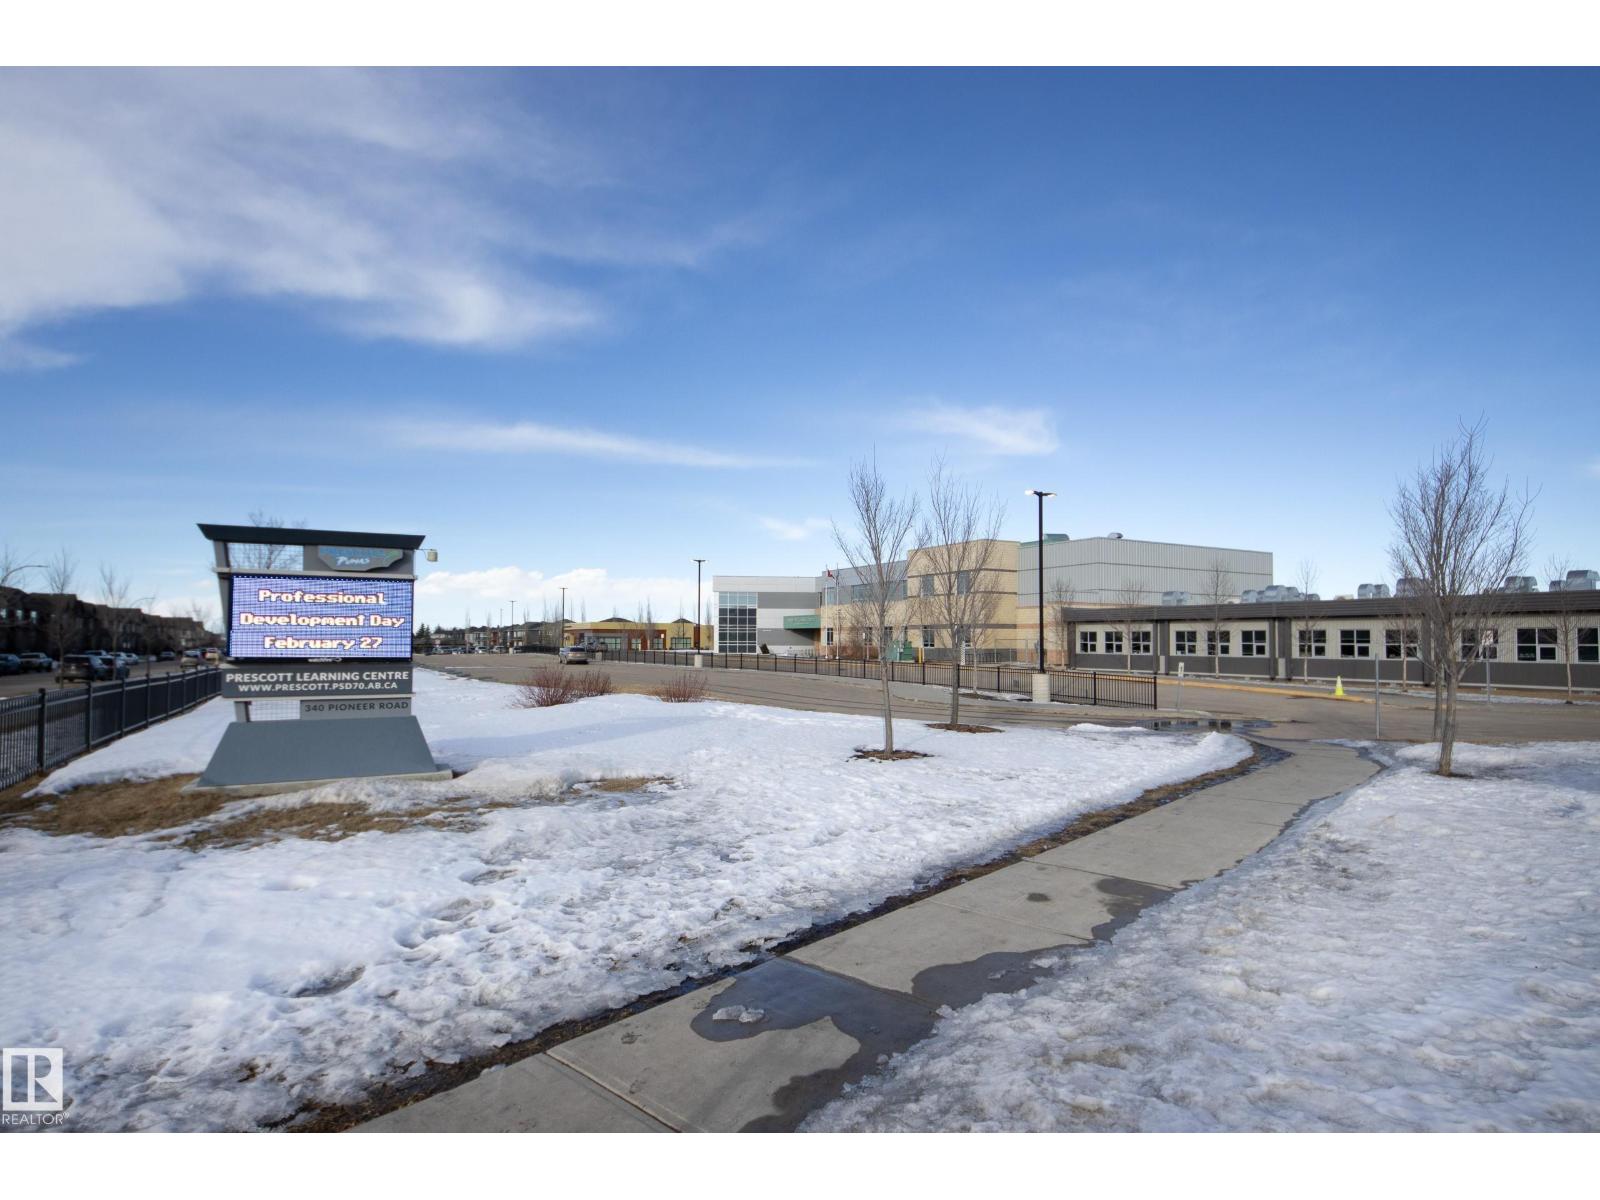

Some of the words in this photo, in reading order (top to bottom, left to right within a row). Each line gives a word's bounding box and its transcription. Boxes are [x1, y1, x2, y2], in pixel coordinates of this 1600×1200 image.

[258, 589, 385, 604] Professional
[239, 612, 366, 627] Development
[369, 614, 405, 628] Day
[264, 636, 356, 650] February
[359, 637, 383, 649] 27
[225, 673, 293, 683] PRESCOTT
[296, 672, 360, 682] LEARNING
[362, 671, 409, 681] CENTRE
[238, 682, 398, 692] WWW.PRESCOTT.PSD70.AB.CA
[305, 704, 325, 712] 340
[328, 703, 375, 711] PIONEER
[379, 702, 409, 710] ROAD
